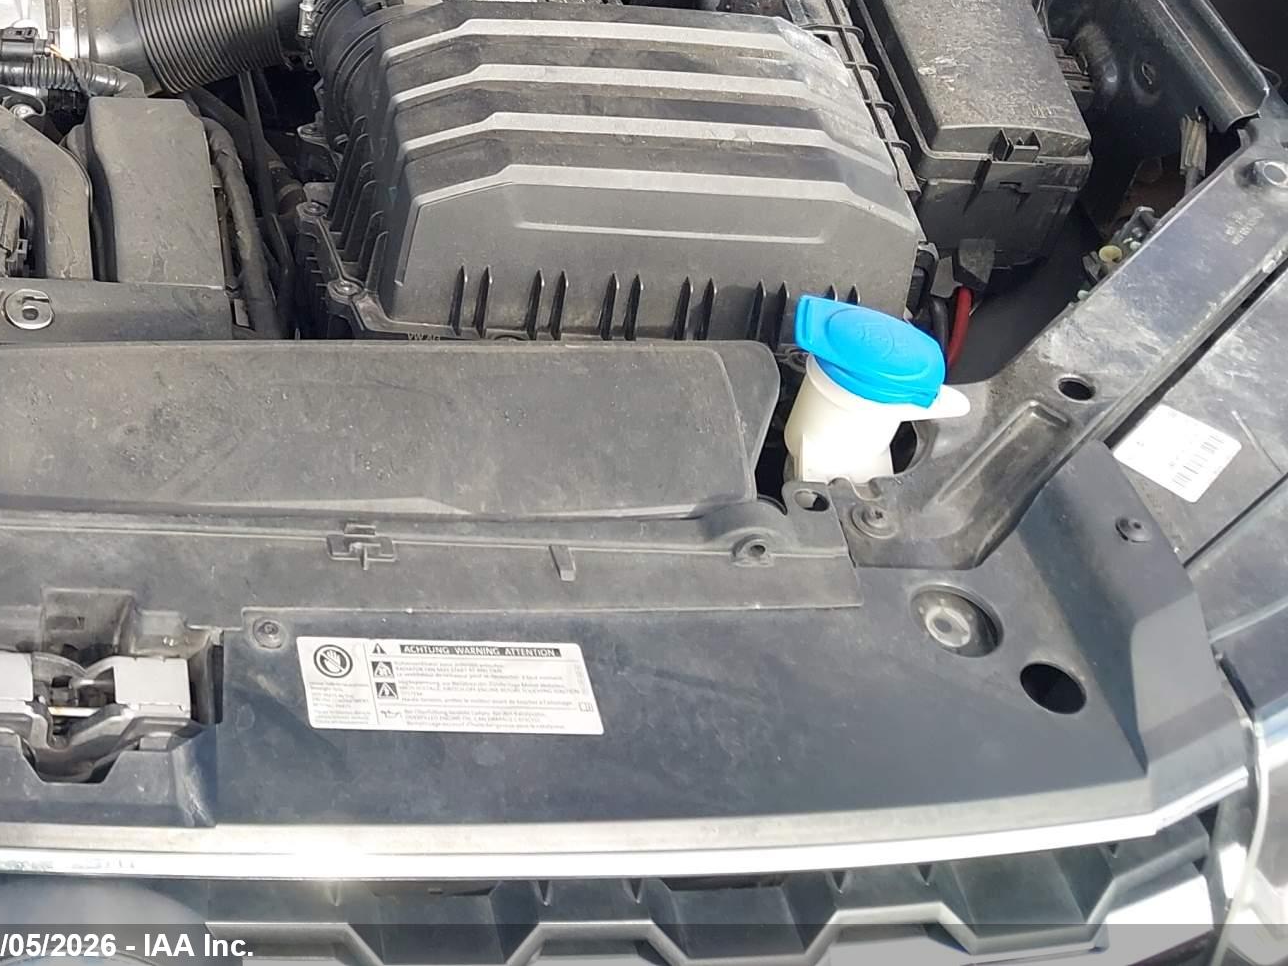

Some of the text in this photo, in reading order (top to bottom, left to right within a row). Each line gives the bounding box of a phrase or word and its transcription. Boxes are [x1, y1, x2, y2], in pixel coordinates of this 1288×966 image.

[403, 646, 555, 658] ACHTUNG WARNING ATTENTION
